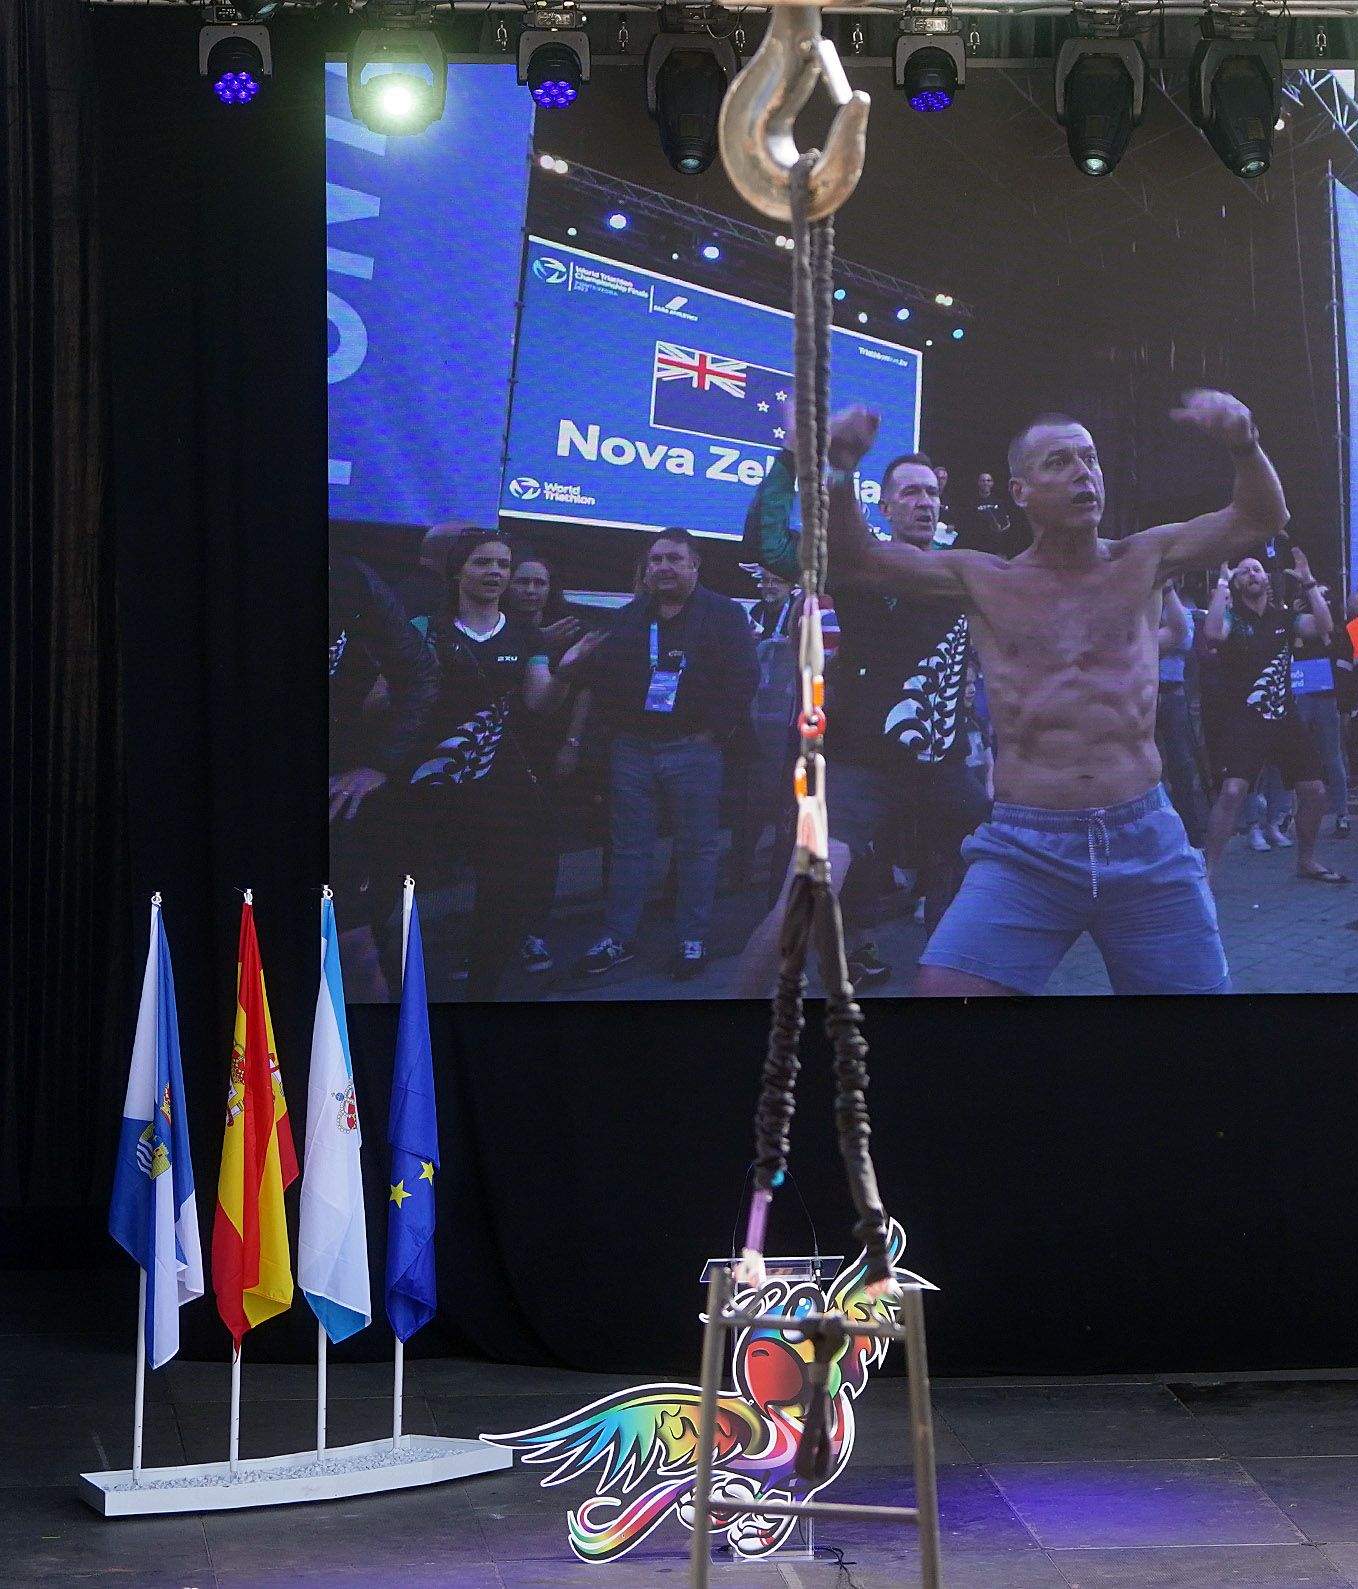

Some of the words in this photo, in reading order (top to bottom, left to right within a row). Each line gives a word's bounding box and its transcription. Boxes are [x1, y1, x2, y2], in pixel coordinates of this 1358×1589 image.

[557, 419, 695, 477] Nova
[544, 482, 581, 495] World
[543, 489, 596, 505] Triathlon
